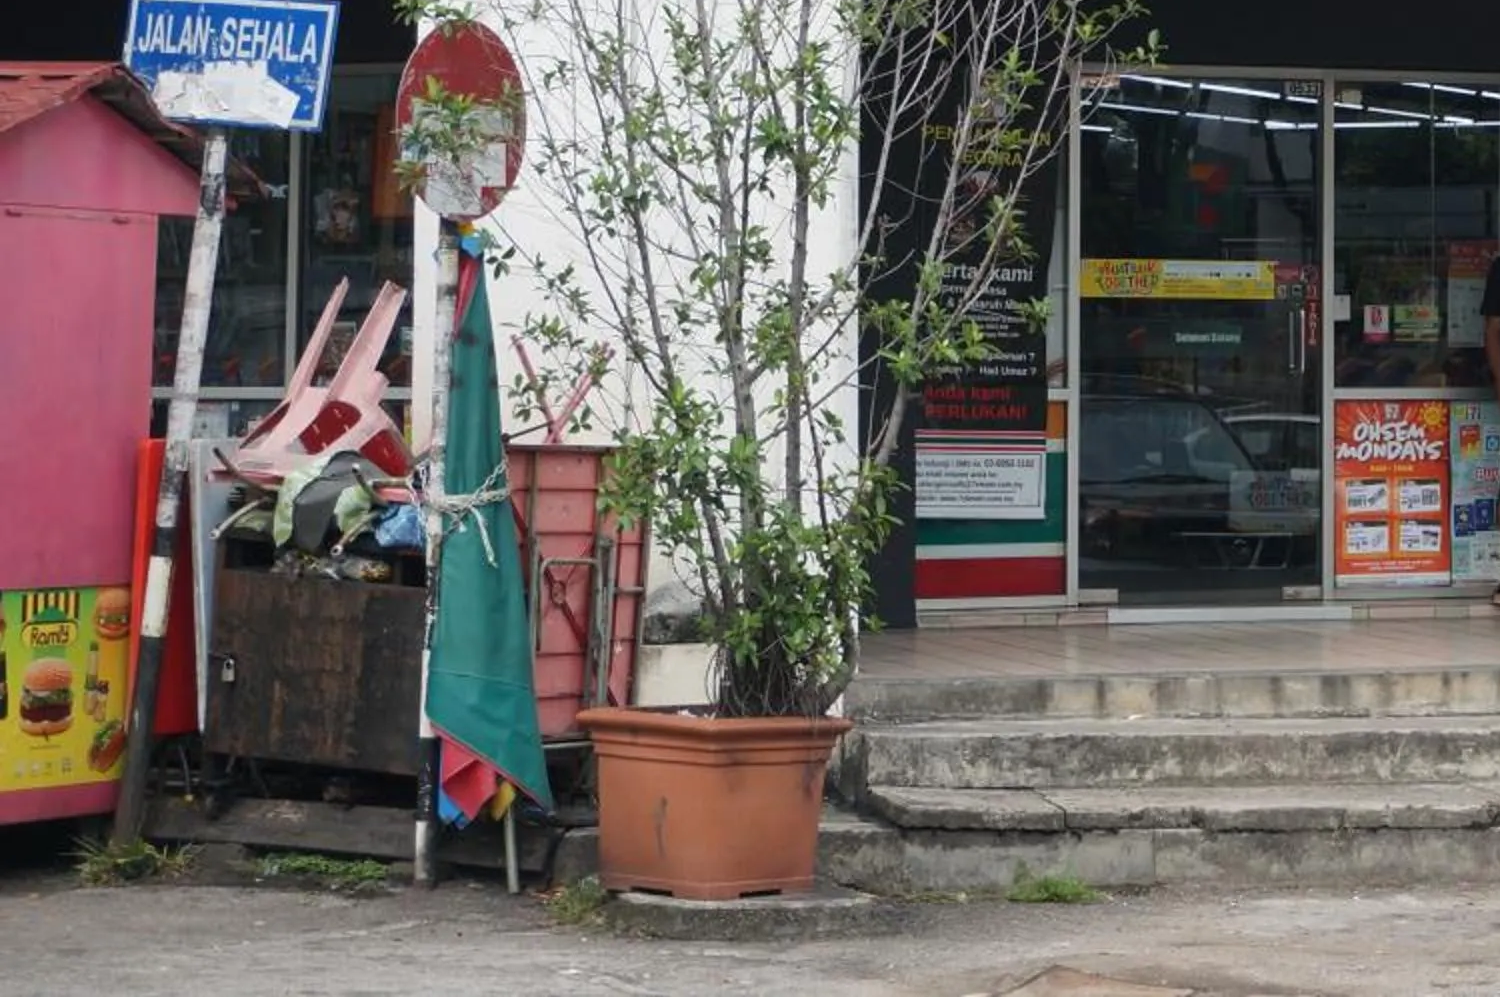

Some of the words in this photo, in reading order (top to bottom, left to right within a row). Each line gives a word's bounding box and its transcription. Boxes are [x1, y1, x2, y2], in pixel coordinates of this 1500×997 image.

[138, 12, 208, 54] JALAN
[219, 16, 317, 63] SEHALA
[1352, 421, 1426, 443] OHSEM
[1335, 440, 1444, 462] MONDAYS
